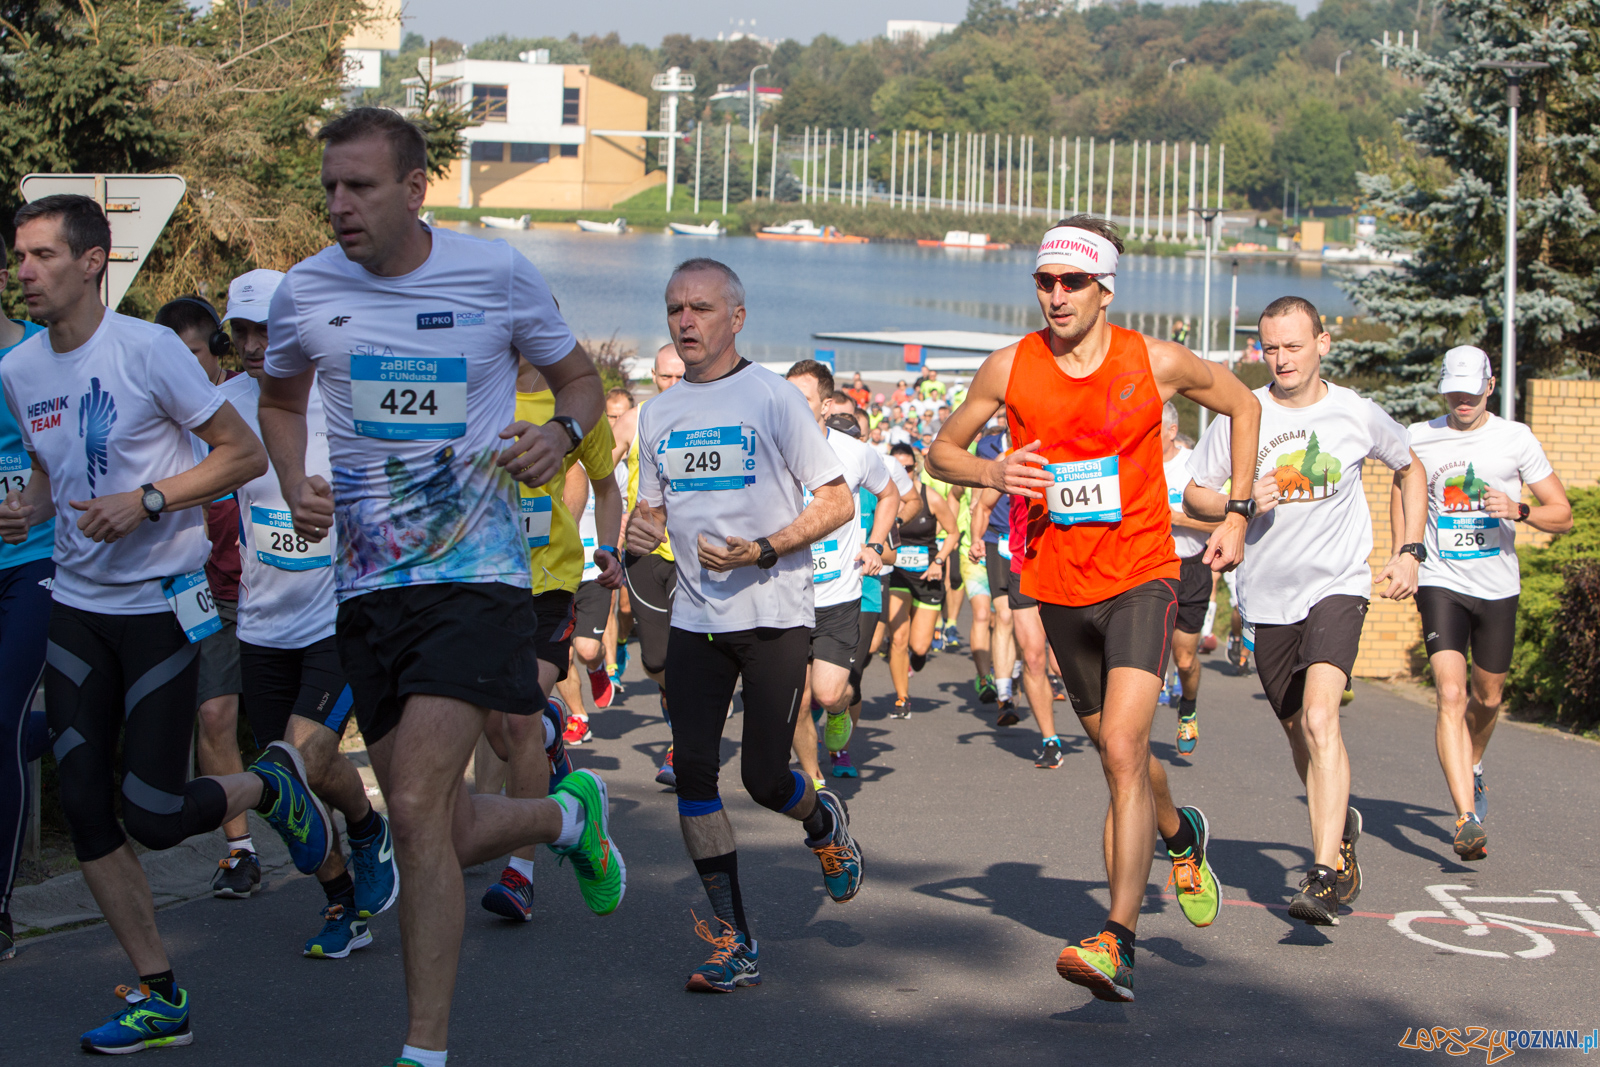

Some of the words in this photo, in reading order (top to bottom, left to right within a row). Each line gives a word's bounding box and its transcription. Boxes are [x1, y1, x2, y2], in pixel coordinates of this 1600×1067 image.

[328, 316, 352, 327] 4F
[432, 316, 451, 324] PKO
[380, 360, 437, 373] zaBIEGaj
[389, 372, 437, 381] FUNdusze
[27, 395, 69, 419] HERNIK
[380, 389, 438, 415] 424
[30, 413, 62, 433] TEAM
[686, 429, 721, 440] zaBIEGaj
[1269, 429, 1307, 449] BIEGAJĄ
[689, 439, 721, 447] FUNdusze
[684, 451, 721, 473] 249
[1056, 461, 1102, 475] zaBIEGaj
[1064, 471, 1102, 481] FUNdusze
[1060, 483, 1103, 508] 041
[269, 512, 292, 521] zaBIE
[274, 520, 294, 528] FUNd
[270, 532, 309, 553] 288
[1454, 532, 1485, 547] 256
[901, 556, 919, 565] 575
